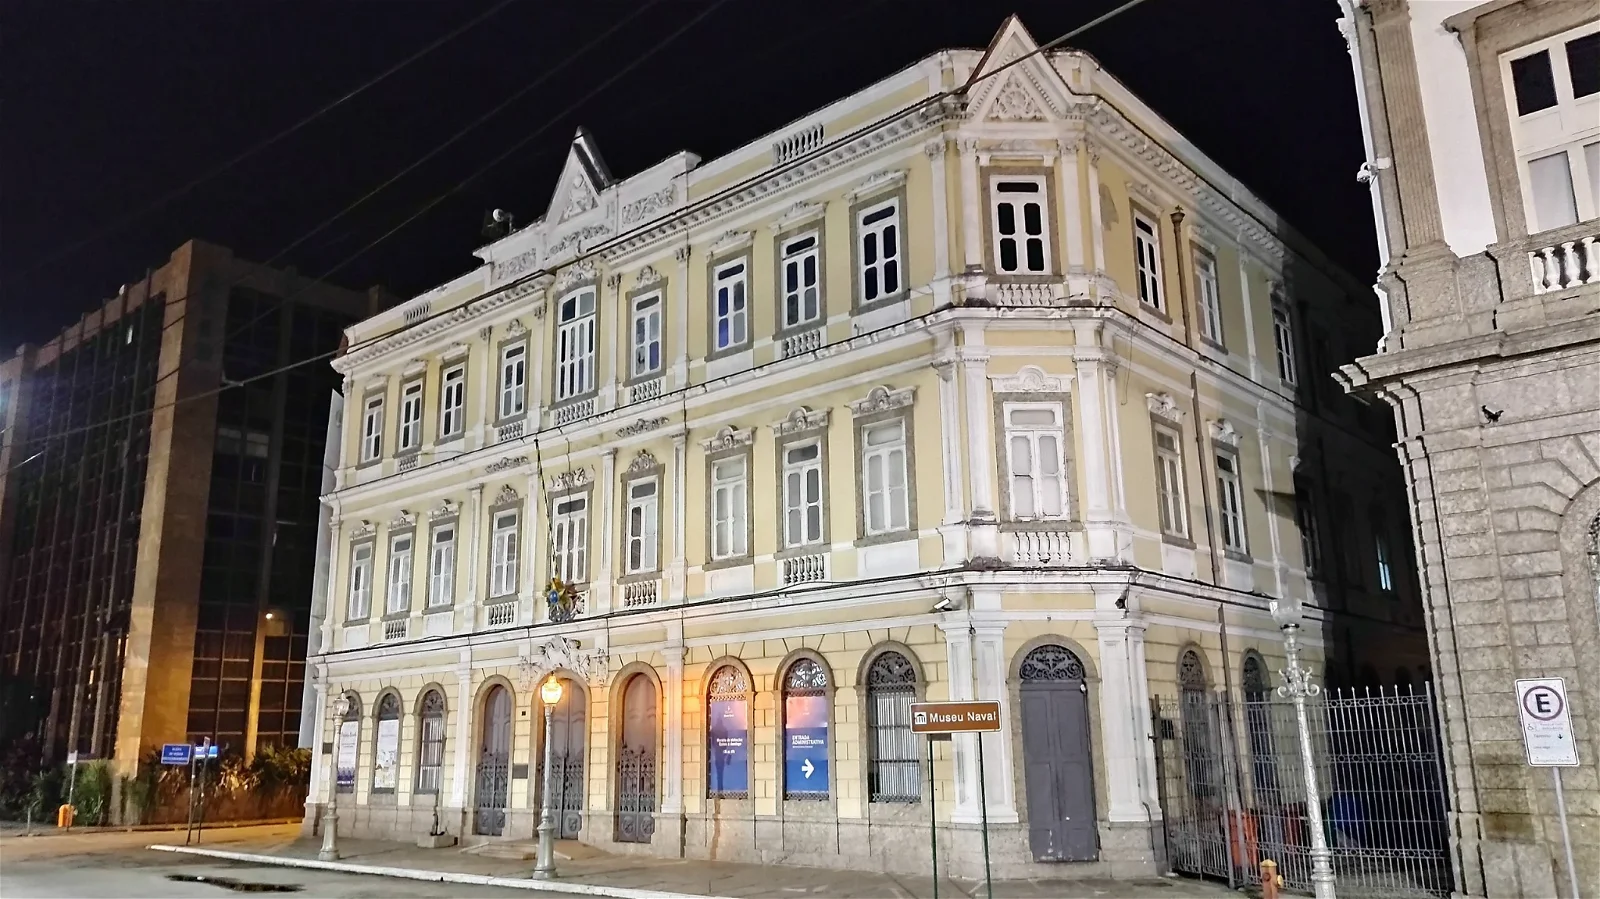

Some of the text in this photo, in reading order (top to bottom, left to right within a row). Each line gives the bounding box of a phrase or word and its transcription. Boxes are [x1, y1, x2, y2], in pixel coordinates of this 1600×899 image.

[1535, 693, 1552, 714] E
[929, 711, 997, 723] Museu Naval
